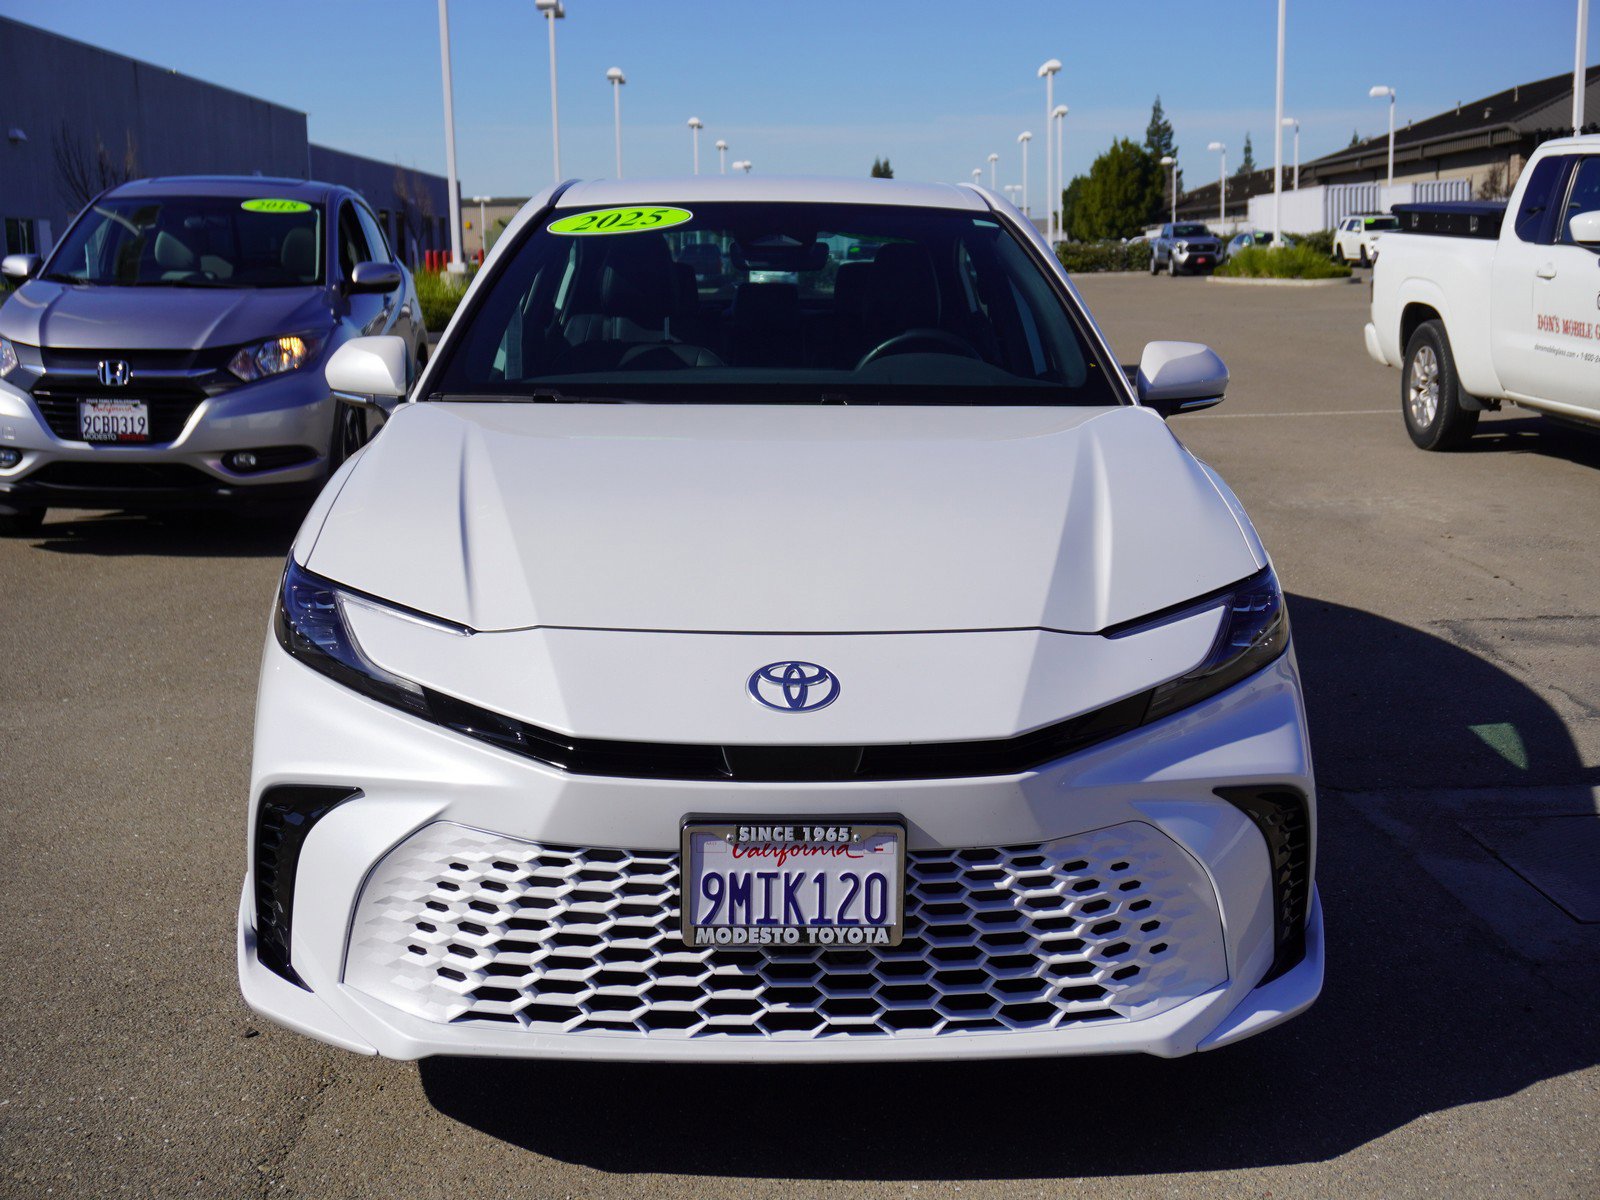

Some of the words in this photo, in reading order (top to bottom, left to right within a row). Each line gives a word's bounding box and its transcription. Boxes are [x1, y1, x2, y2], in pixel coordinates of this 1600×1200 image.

[571, 209, 670, 232] 2025
[1537, 314, 1560, 334] DON'S
[1562, 319, 1593, 339] MOBILE
[83, 415, 146, 435] 9CBD319
[83, 432, 117, 441] MODESTO
[738, 826, 794, 843] SINCE
[803, 826, 850, 843] 1965
[732, 843, 864, 868] California
[701, 871, 889, 925] 9MIK120
[695, 927, 800, 945] MODESTO
[806, 927, 890, 945] TOYOTA
